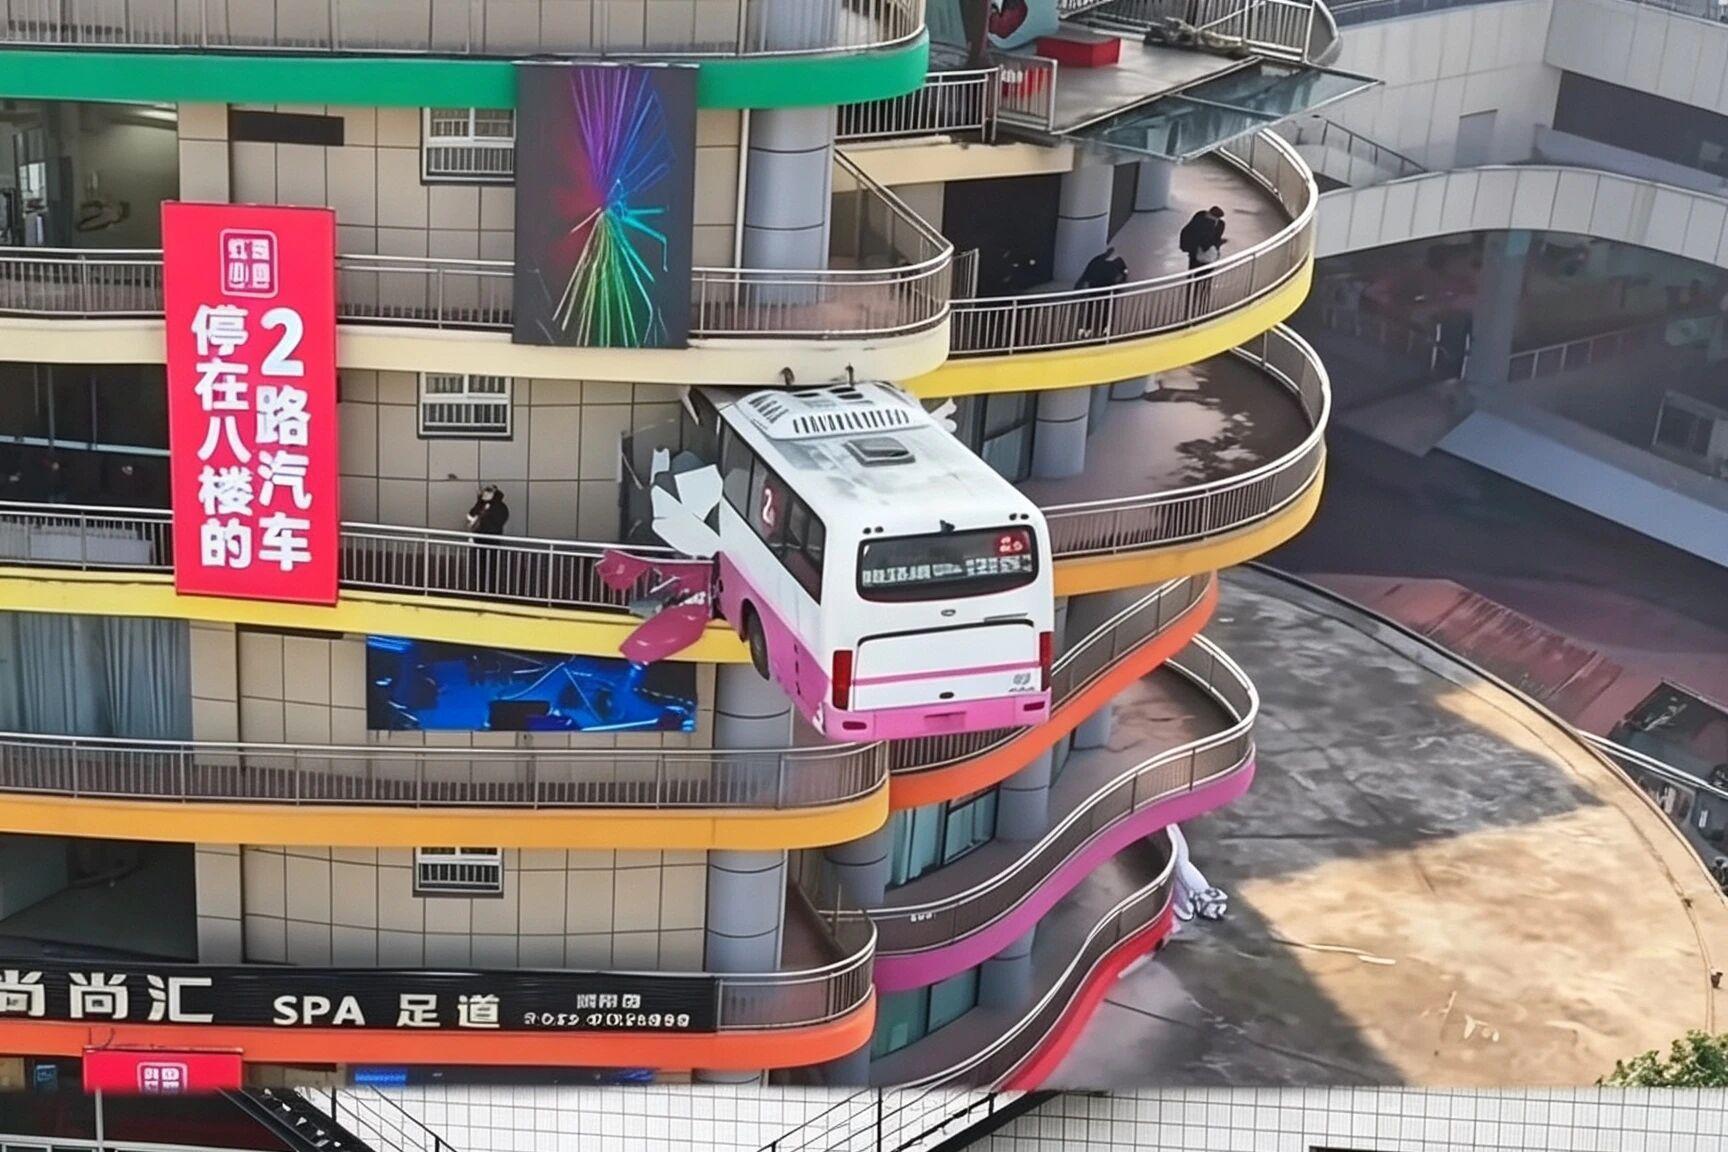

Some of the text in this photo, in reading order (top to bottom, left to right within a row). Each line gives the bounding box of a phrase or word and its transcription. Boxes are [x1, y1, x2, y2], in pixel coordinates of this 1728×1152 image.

[191, 304, 254, 568] 停在八楼的
[255, 307, 312, 571] 2路汽车
[0, 969, 213, 1023] 尚尚汇
[273, 995, 366, 1026] SPA
